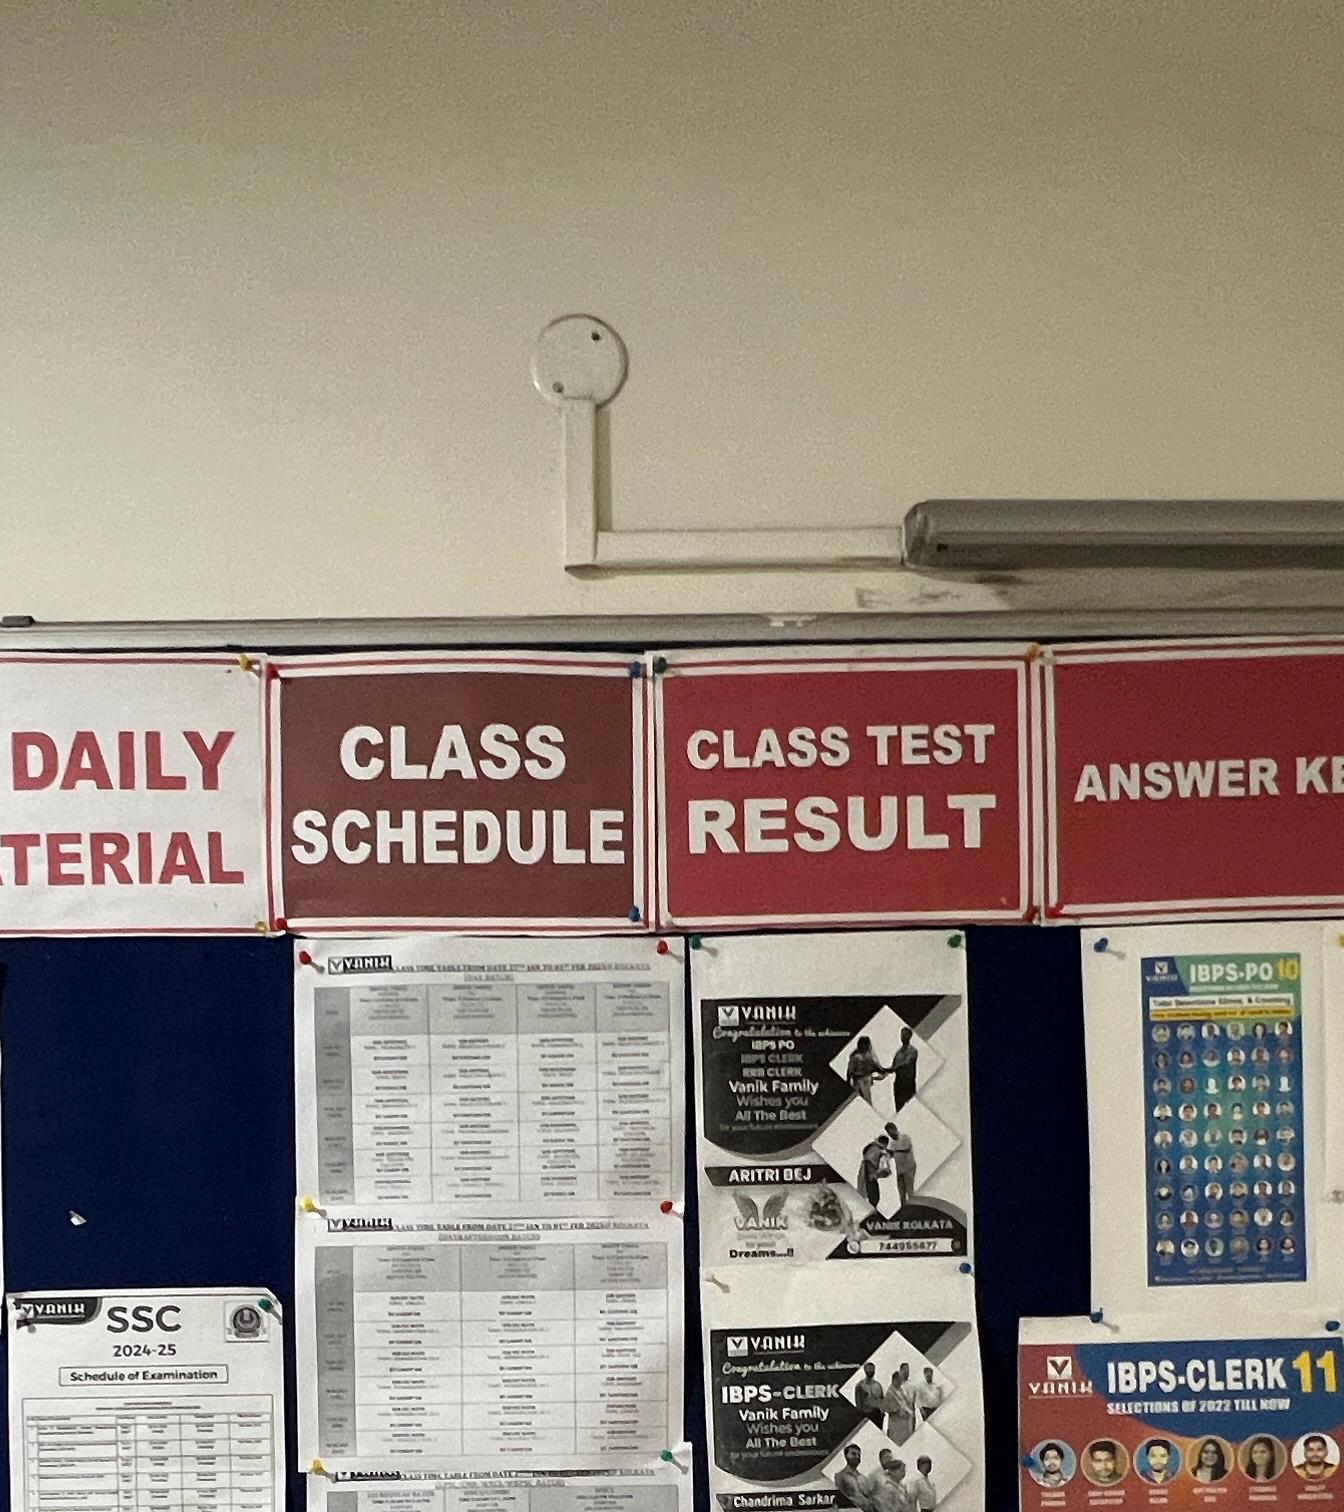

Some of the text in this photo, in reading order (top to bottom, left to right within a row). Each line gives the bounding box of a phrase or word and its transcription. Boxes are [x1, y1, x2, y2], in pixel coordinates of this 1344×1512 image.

[339, 723, 565, 780] CLASS
[686, 724, 995, 769] CLASS TEST
[11, 730, 235, 791] DAILY
[1074, 758, 1279, 801] ANSWER
[687, 794, 996, 854] RESULT
[291, 808, 625, 866] SCHEDULE
[1190, 962, 1273, 983] IBPS-PO
[729, 1079, 819, 1095] Vanik Family
[736, 1096, 808, 1109] Wishes you
[736, 1110, 807, 1120] All The Best
[729, 1169, 779, 1182] ARITRI
[734, 1216, 788, 1230] VANIK
[107, 1305, 182, 1333] SSC
[113, 1344, 177, 1358] 2024-25
[70, 1369, 218, 1383] Schedule of Examination
[1107, 1357, 1286, 1395] IBPS-CLERK
[1292, 1350, 1337, 1393] 11
[722, 1384, 840, 1404] IBPS-CLERK
[739, 1405, 829, 1421] Vanik Family
[1106, 1402, 1178, 1415] SELECTIONS
[1234, 1399, 1257, 1411] TILL
[1259, 1398, 1290, 1410] NOW
[746, 1422, 819, 1435] Wishes you
[746, 1437, 817, 1448] All The Best
[734, 1493, 835, 1507] Chandrima Sarkar
